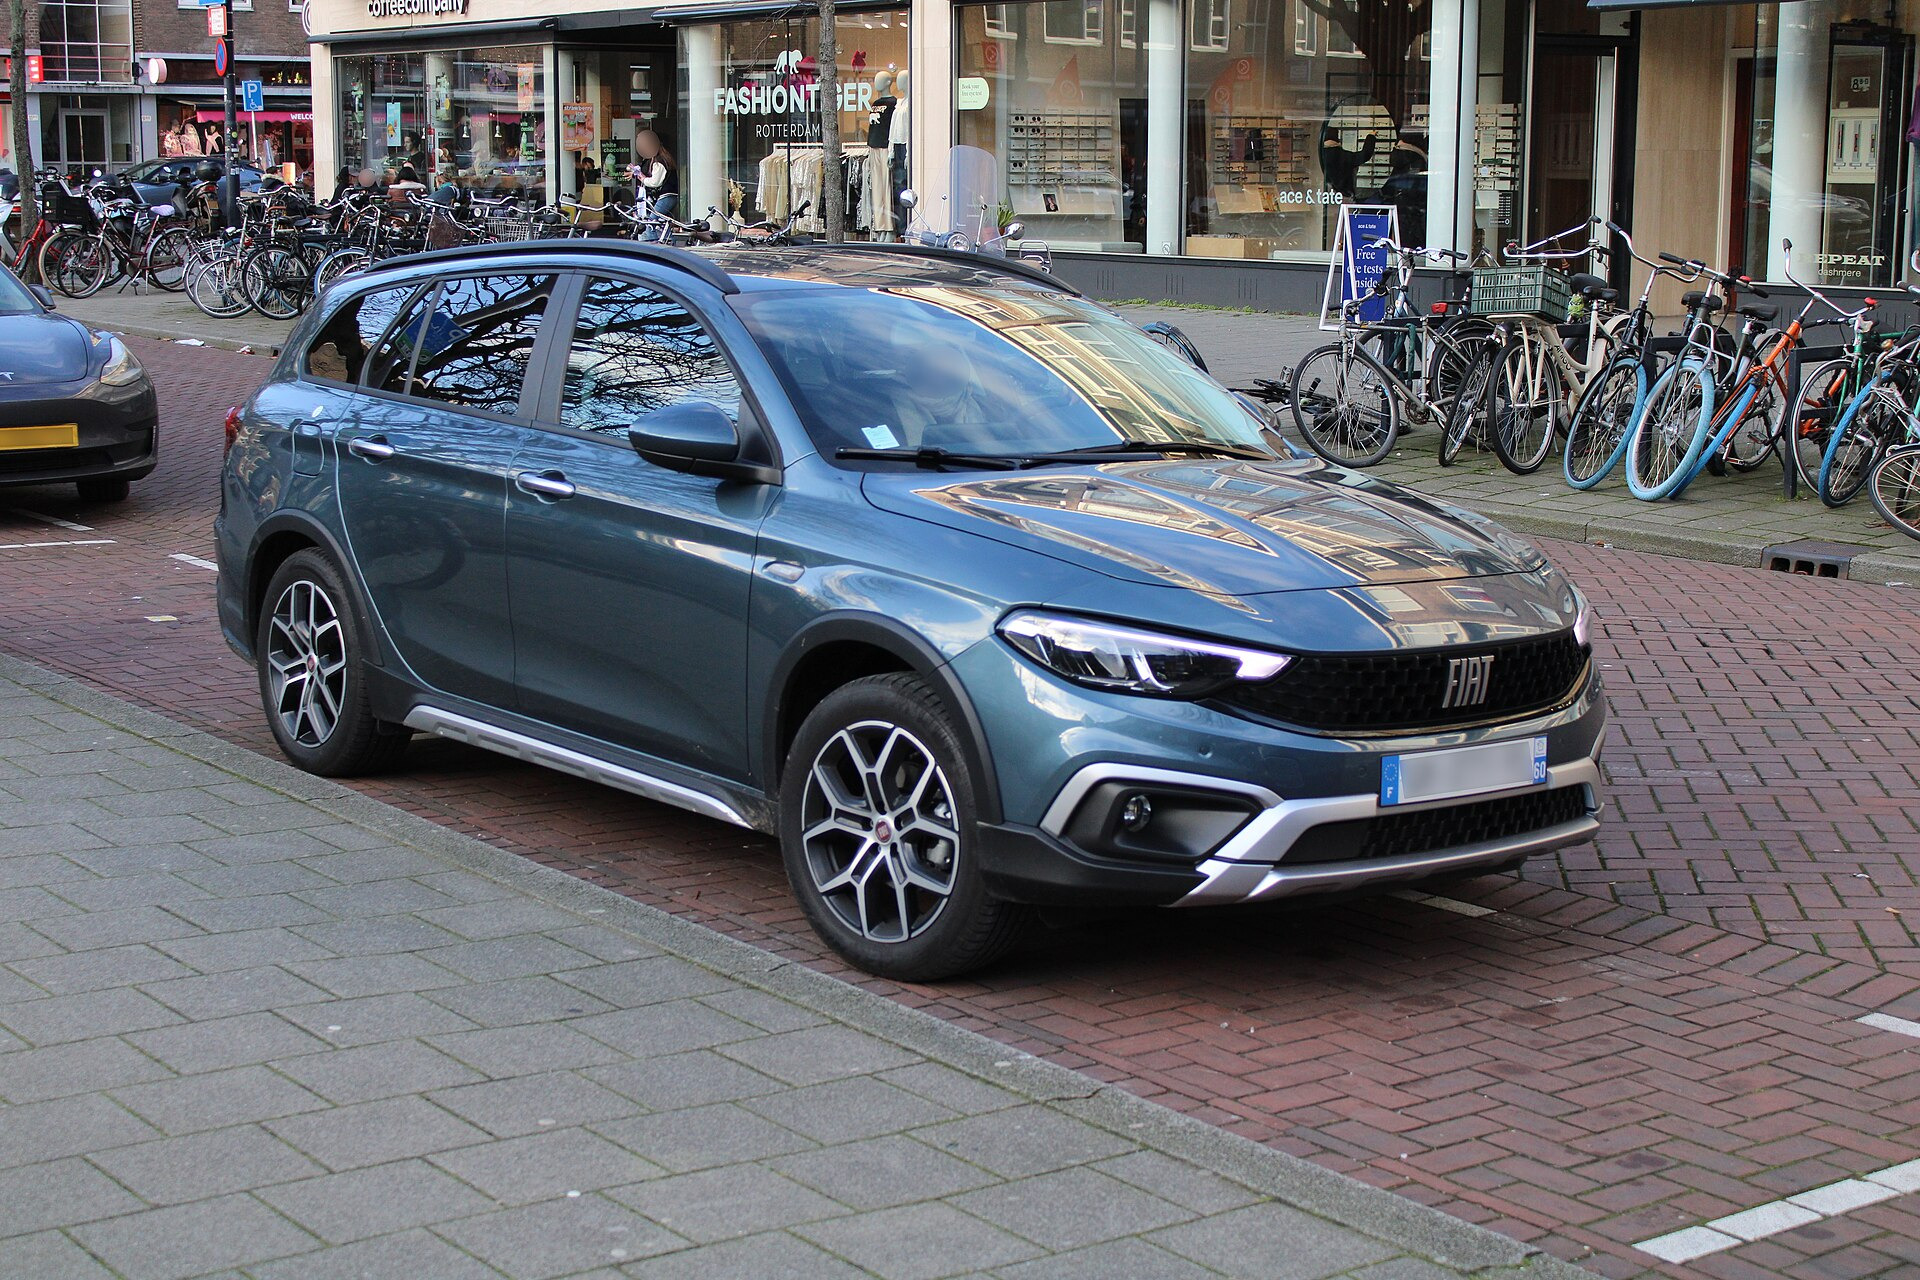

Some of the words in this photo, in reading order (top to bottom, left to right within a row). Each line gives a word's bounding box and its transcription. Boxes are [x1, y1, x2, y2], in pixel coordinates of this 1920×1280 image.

[367, 0, 466, 16] coffeecompany
[713, 82, 872, 115] FASHIONTER
[756, 123, 821, 138] ROTTERDAM
[1279, 191, 1303, 204] ace
[1306, 189, 1315, 204] &
[1316, 189, 1343, 205] tate
[1356, 248, 1376, 260] Free
[1800, 253, 1885, 266] EPEAT
[1346, 265, 1362, 274] ee
[1363, 264, 1384, 274] tests
[1818, 268, 1862, 278] cashmere
[1442, 655, 1494, 709] FIAT
[1533, 761, 1546, 780] 60
[1386, 787, 1393, 798] F
